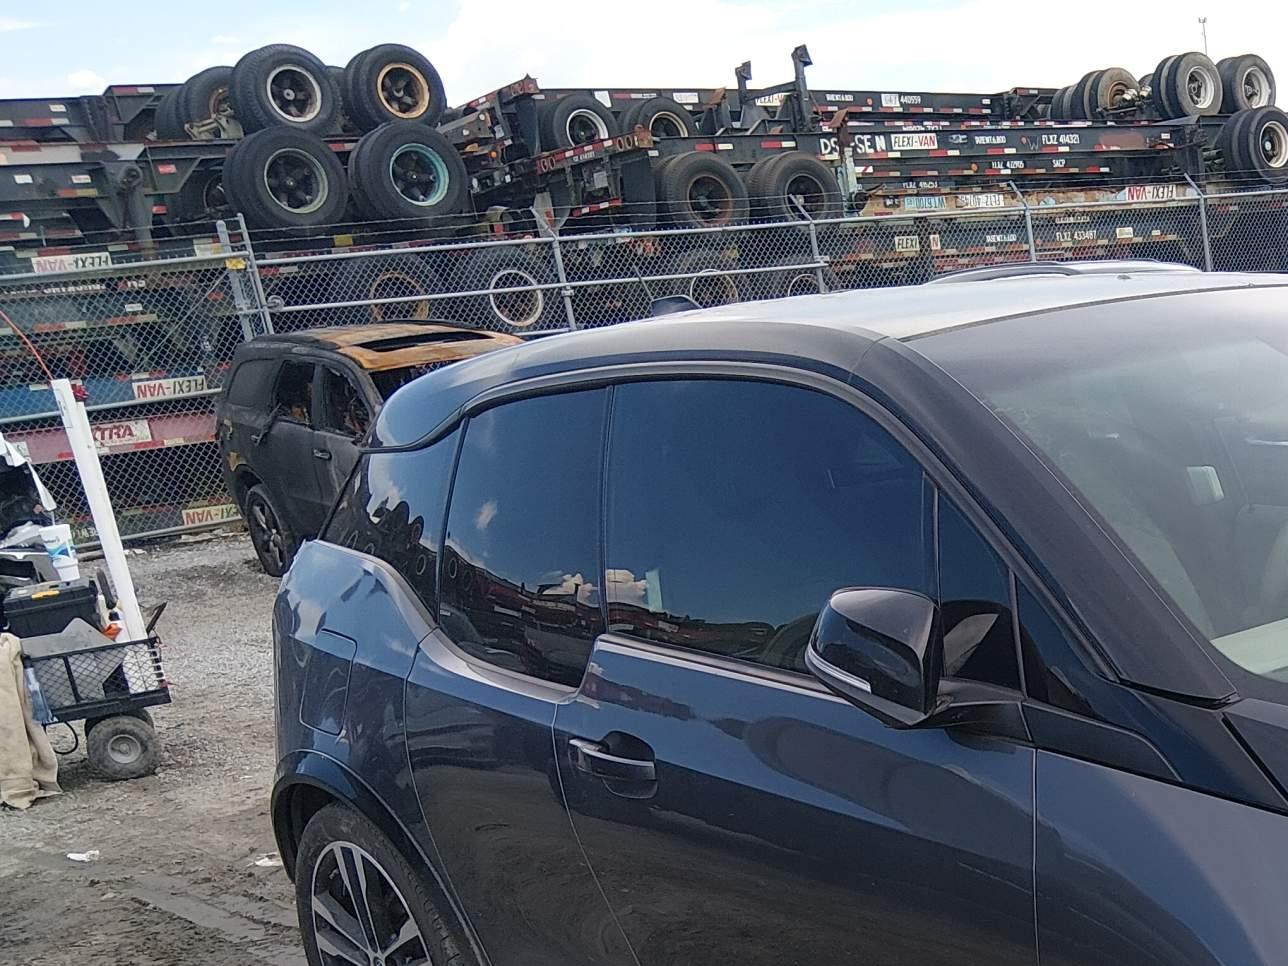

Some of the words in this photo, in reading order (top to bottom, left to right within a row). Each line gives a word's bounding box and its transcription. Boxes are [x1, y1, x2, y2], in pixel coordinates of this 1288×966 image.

[892, 133, 938, 149] FLEXI-VAN
[1127, 184, 1174, 201] FLEXI-VAN
[34, 255, 109, 273] FLEXI-VAN
[136, 378, 205, 399] FLEXI-VAN
